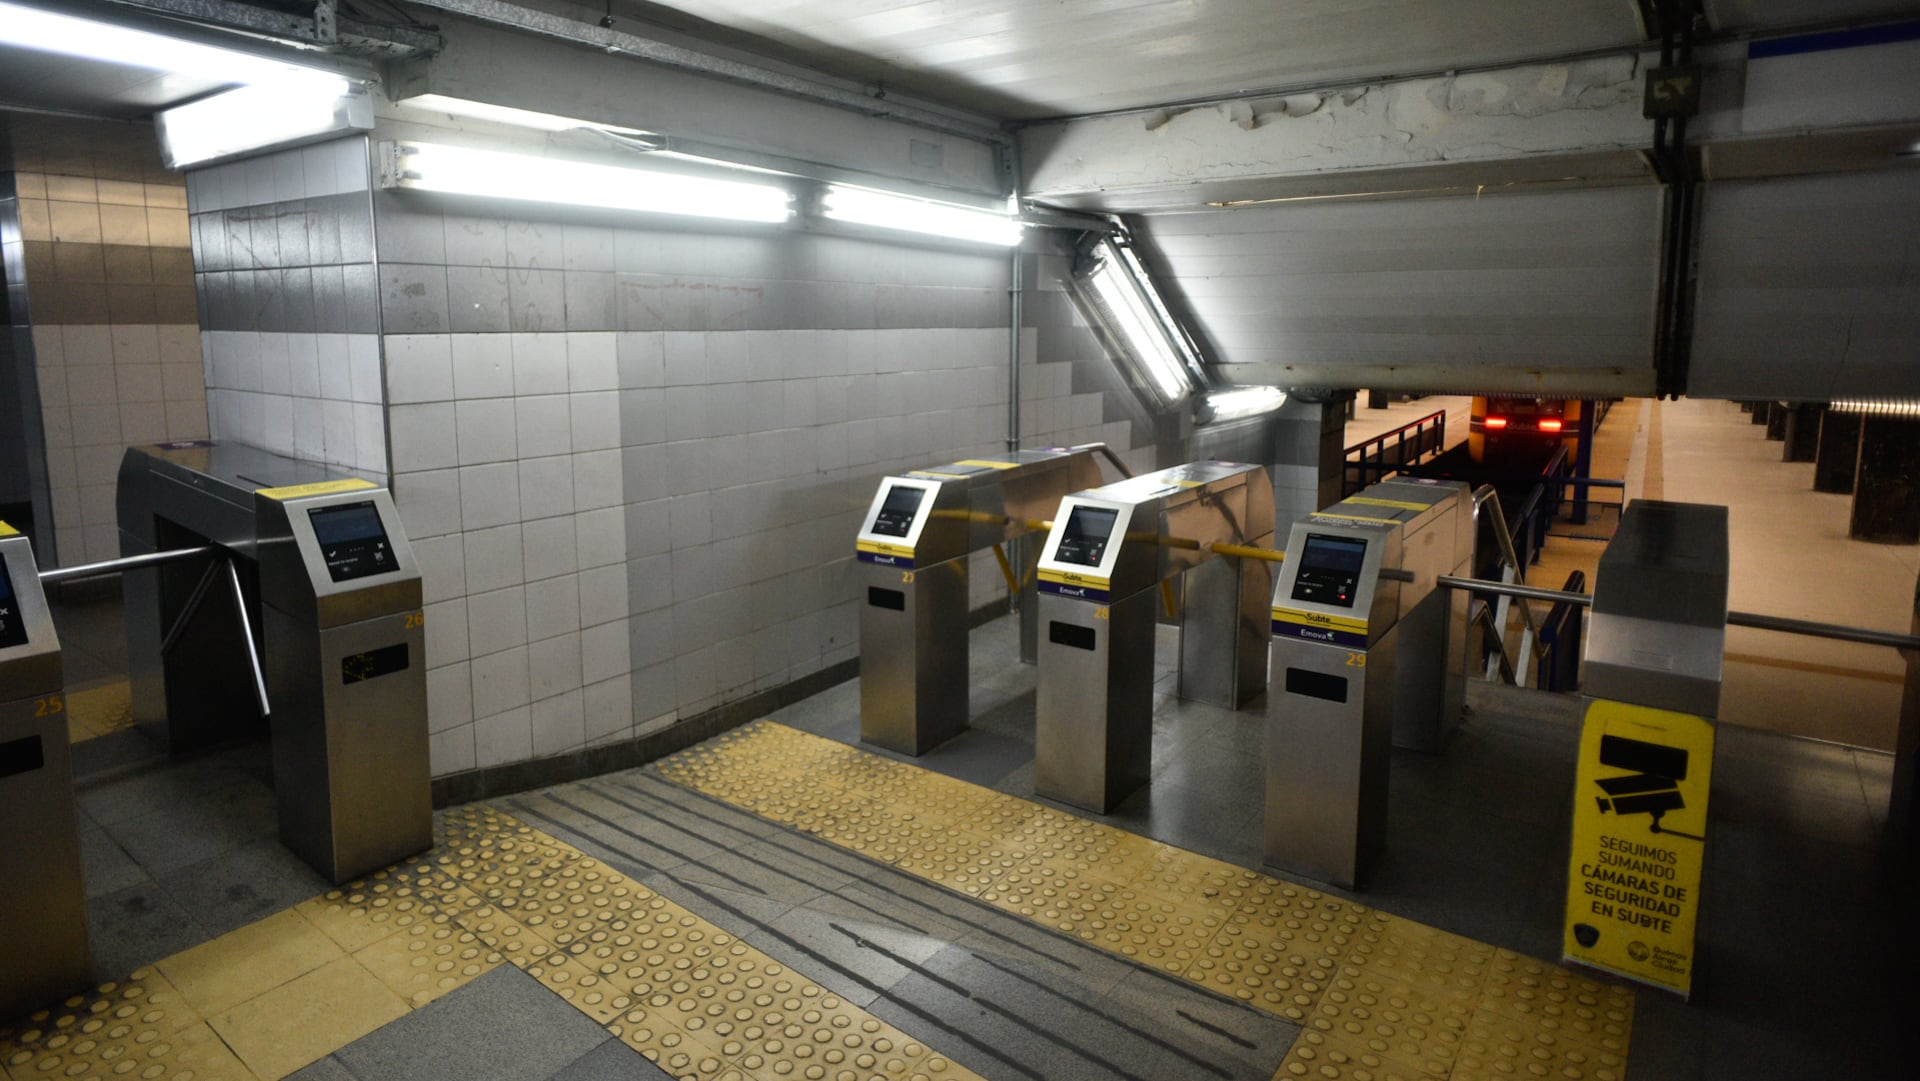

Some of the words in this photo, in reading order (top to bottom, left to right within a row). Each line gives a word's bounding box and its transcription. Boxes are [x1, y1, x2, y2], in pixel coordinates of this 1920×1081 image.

[902, 570, 914, 584] 27
[1059, 587, 1080, 596] Emova
[404, 611, 425, 630] 26
[1305, 612, 1332, 624] Subte
[1300, 628, 1327, 640] Emova
[1345, 651, 1367, 668] 29
[33, 696, 64, 718] 25
[1600, 835, 1677, 865] SEGUIMOS
[1598, 851, 1676, 881] SUMANDO
[1581, 863, 1660, 895] CÁMARAS
[1663, 885, 1688, 902] DE
[1584, 881, 1681, 918] SEGURIDAD
[1591, 901, 1614, 918] EN
[1617, 908, 1673, 934] SUBTE
